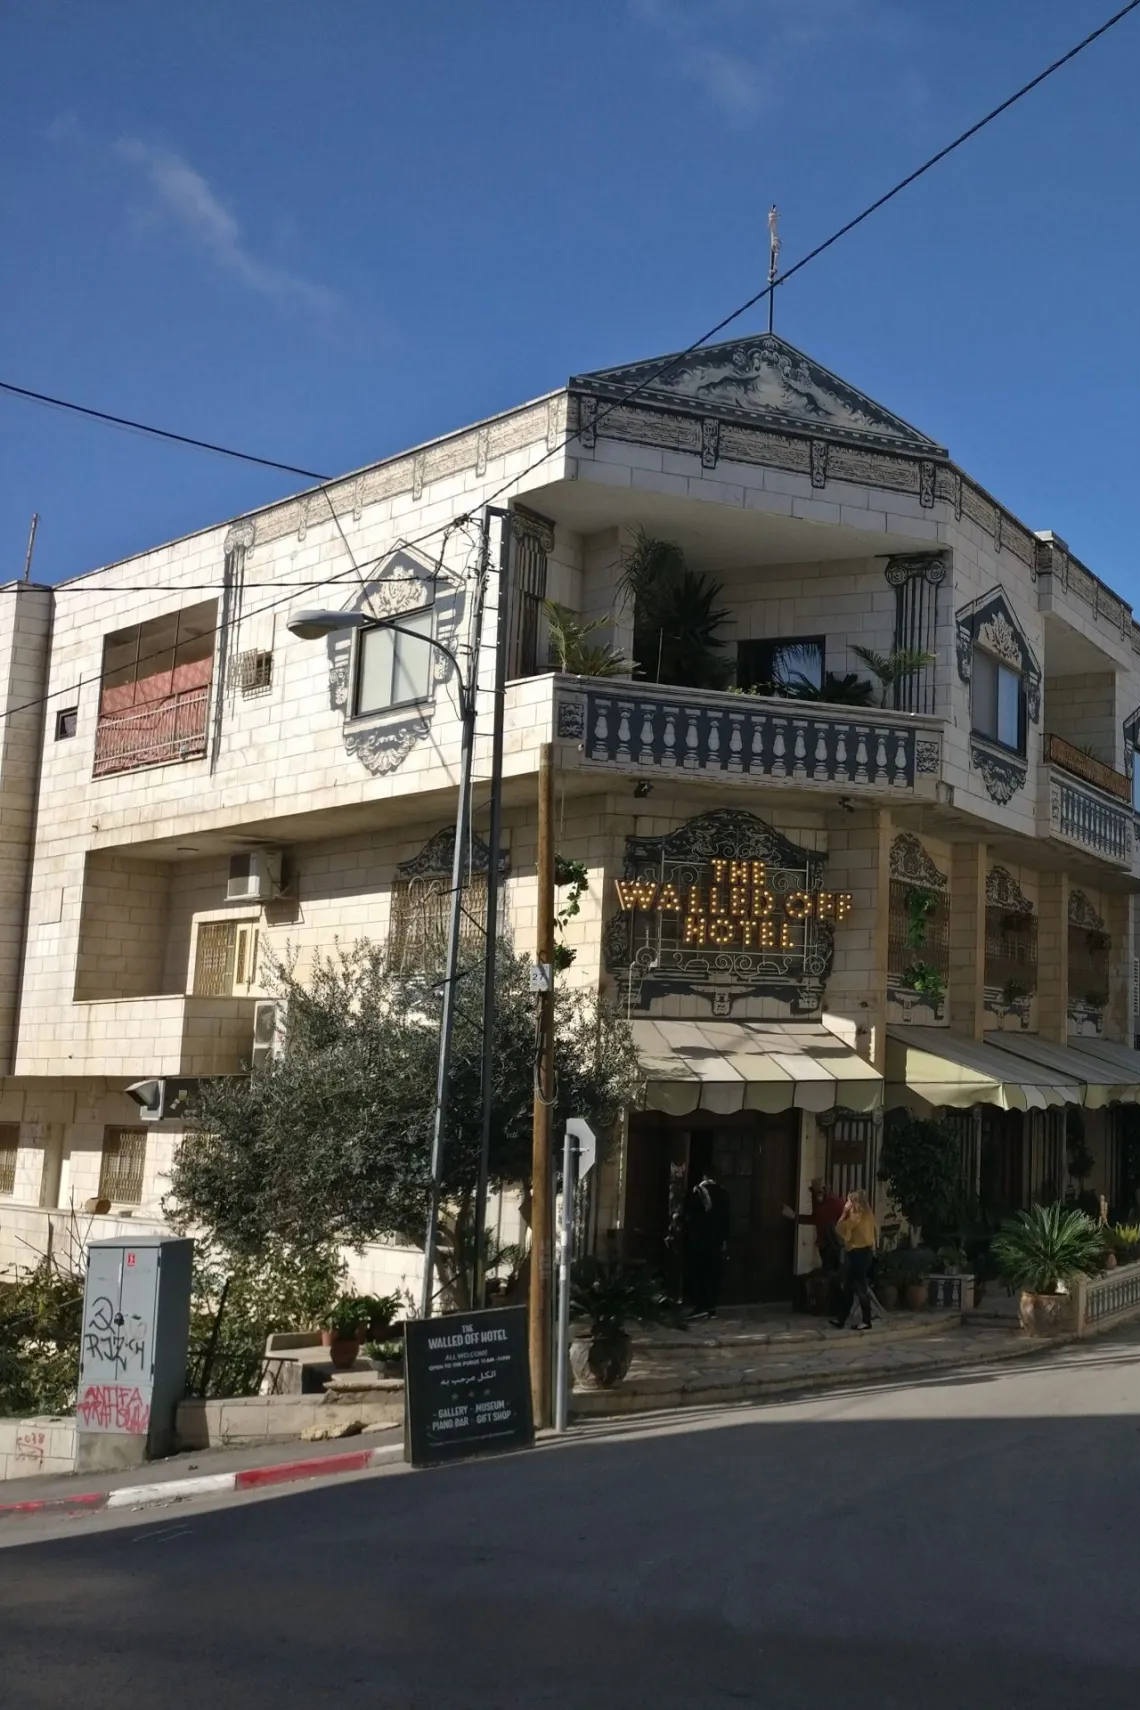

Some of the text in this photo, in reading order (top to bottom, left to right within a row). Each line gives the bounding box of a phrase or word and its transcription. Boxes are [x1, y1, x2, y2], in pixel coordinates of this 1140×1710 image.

[711, 859, 767, 885] THE
[784, 891, 853, 922] OFF
[683, 916, 795, 948] HOTEL
[428, 1329, 508, 1350] WALLED OFF HOTEL
[457, 1350, 488, 1360] WELCOME
[438, 1400, 505, 1418] GALLERY MUSEUM
[432, 1410, 512, 1432] PIANO BAR GIFT SHOP
